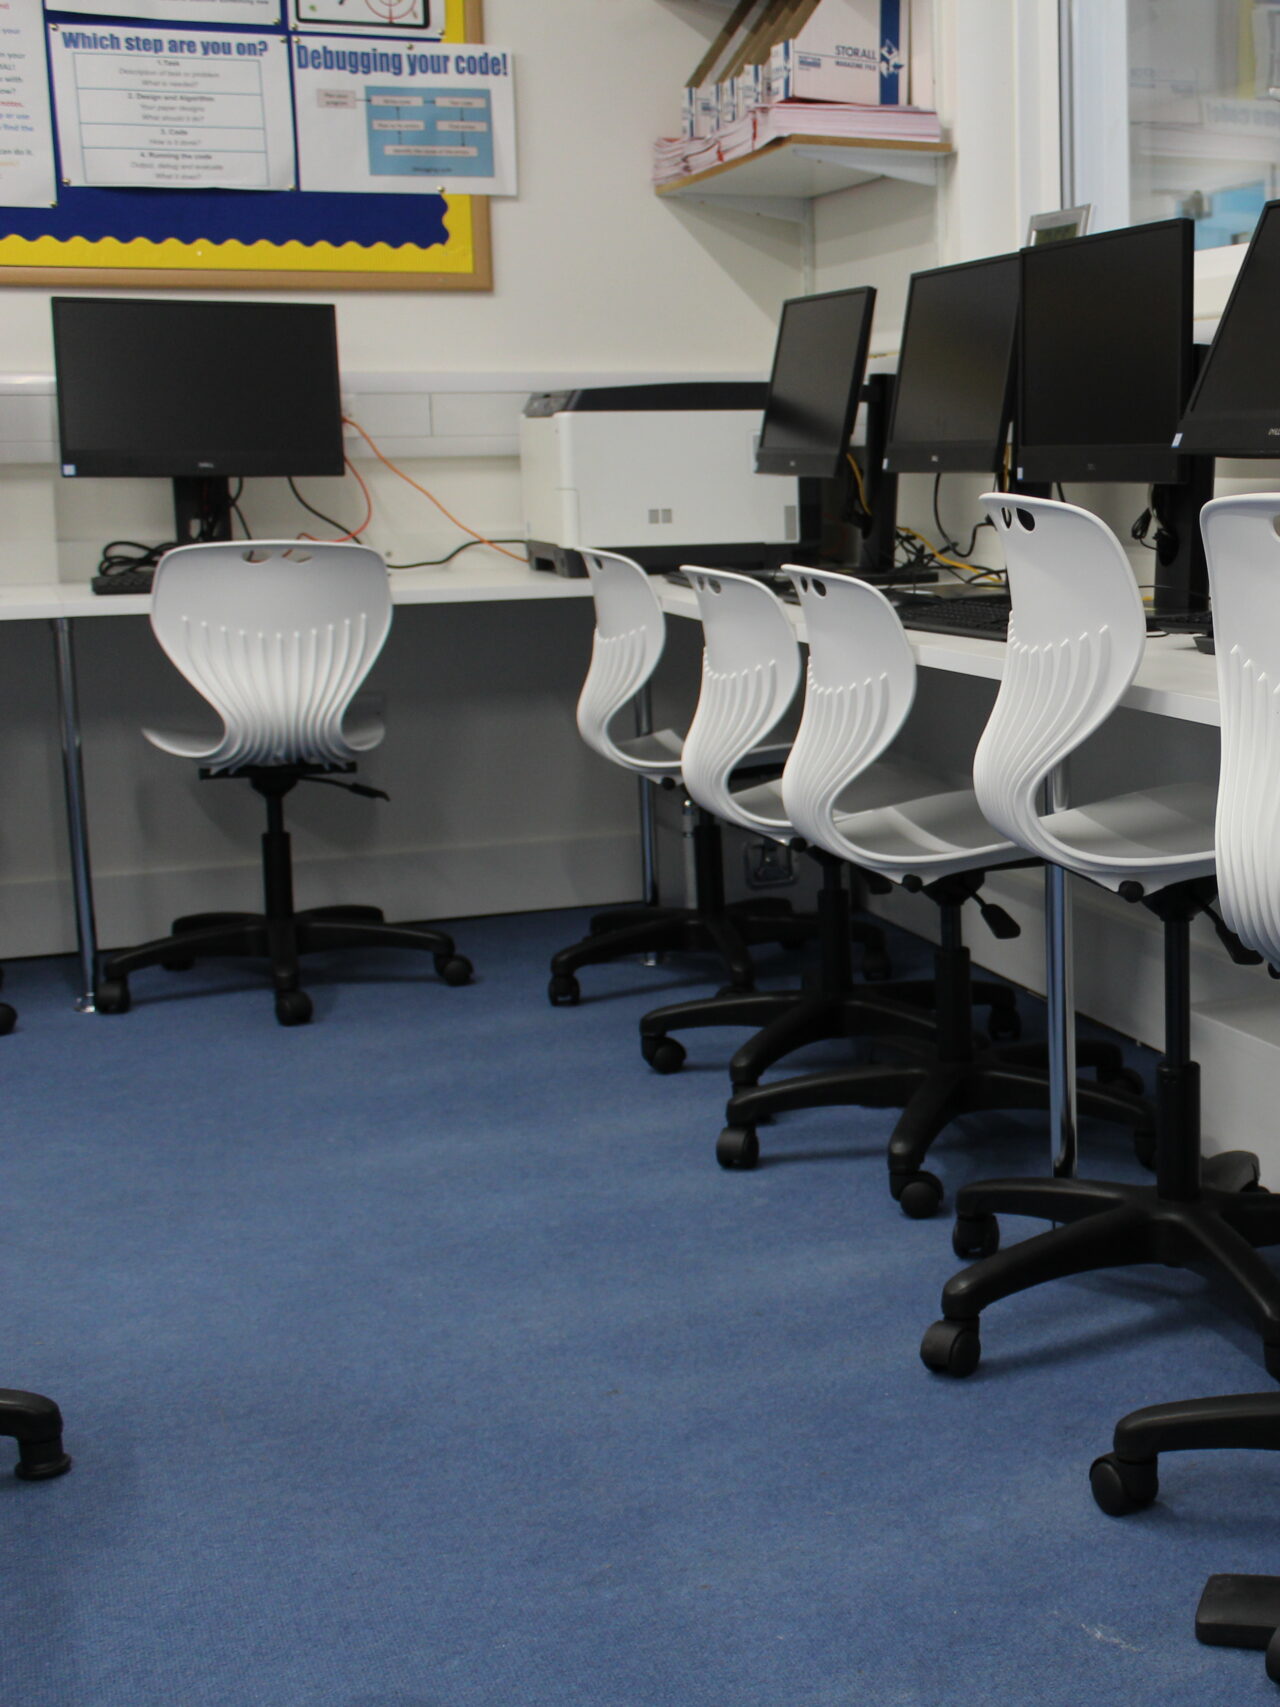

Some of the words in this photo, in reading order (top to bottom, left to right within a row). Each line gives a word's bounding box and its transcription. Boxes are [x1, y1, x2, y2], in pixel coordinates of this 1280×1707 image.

[62, 31, 121, 51] Which
[125, 36, 164, 54] step
[168, 38, 197, 54] are
[200, 40, 232, 56] you
[237, 41, 268, 56] on?
[296, 44, 403, 76] Debugging
[407, 52, 450, 76] your
[455, 52, 509, 76] code!
